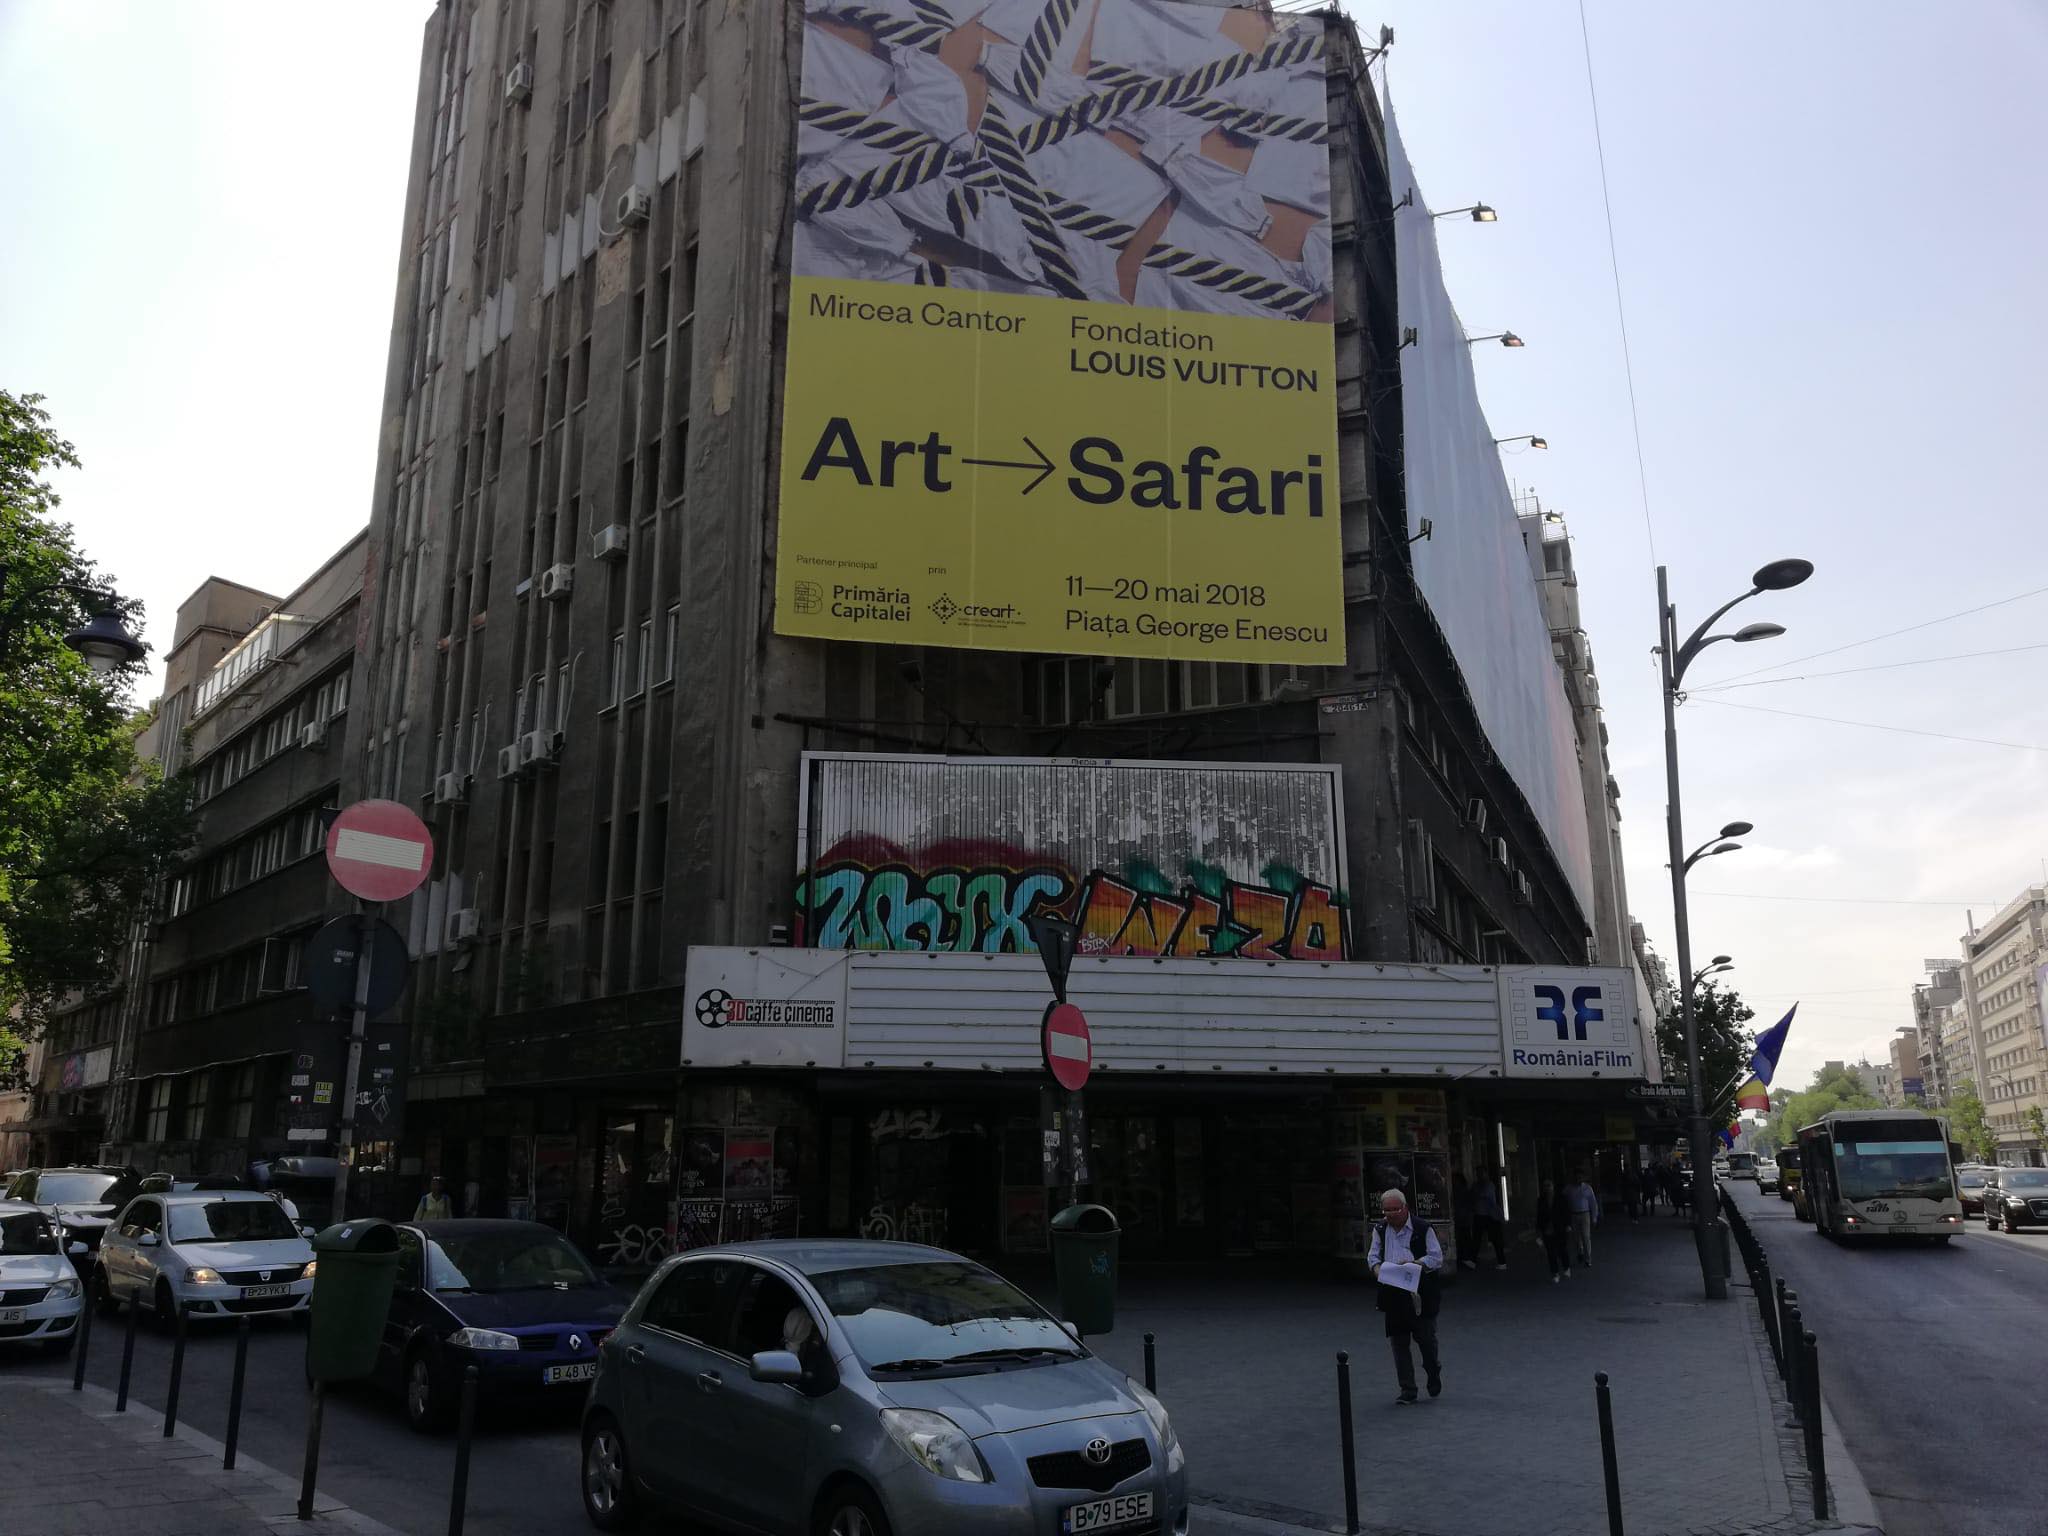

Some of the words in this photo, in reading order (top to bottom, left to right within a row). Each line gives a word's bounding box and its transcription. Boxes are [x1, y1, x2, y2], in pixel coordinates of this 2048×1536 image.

[809, 293, 914, 326] Mircea
[920, 302, 1026, 334] Cantor
[1071, 316, 1214, 352] Fondation
[1070, 349, 1166, 379] LOUIS
[1175, 358, 1318, 392] VUITTON
[801, 417, 952, 492] Art
[1067, 437, 1324, 517] Safari
[796, 554, 836, 567] Partener
[838, 559, 878, 570] principal
[928, 566, 947, 576] prin
[833, 585, 910, 604] Primăria
[1155, 584, 1201, 606] mai
[1205, 584, 1266, 607] 2018
[831, 603, 911, 623] Capitalei
[963, 604, 1016, 619] creart
[1136, 615, 1229, 644] George
[1235, 620, 1329, 643] Enescu
[784, 1004, 834, 1024] cinema
[1513, 1049, 1632, 1067] RomâniaFilm
[1640, 1085, 1655, 1096] Strada
[552, 1367, 561, 1380] B
[566, 1366, 579, 1378] 48
[582, 1364, 598, 1377] VS
[1075, 1506, 1088, 1528] B
[1093, 1502, 1111, 1525] 79
[1114, 1494, 1148, 1521] ESE
